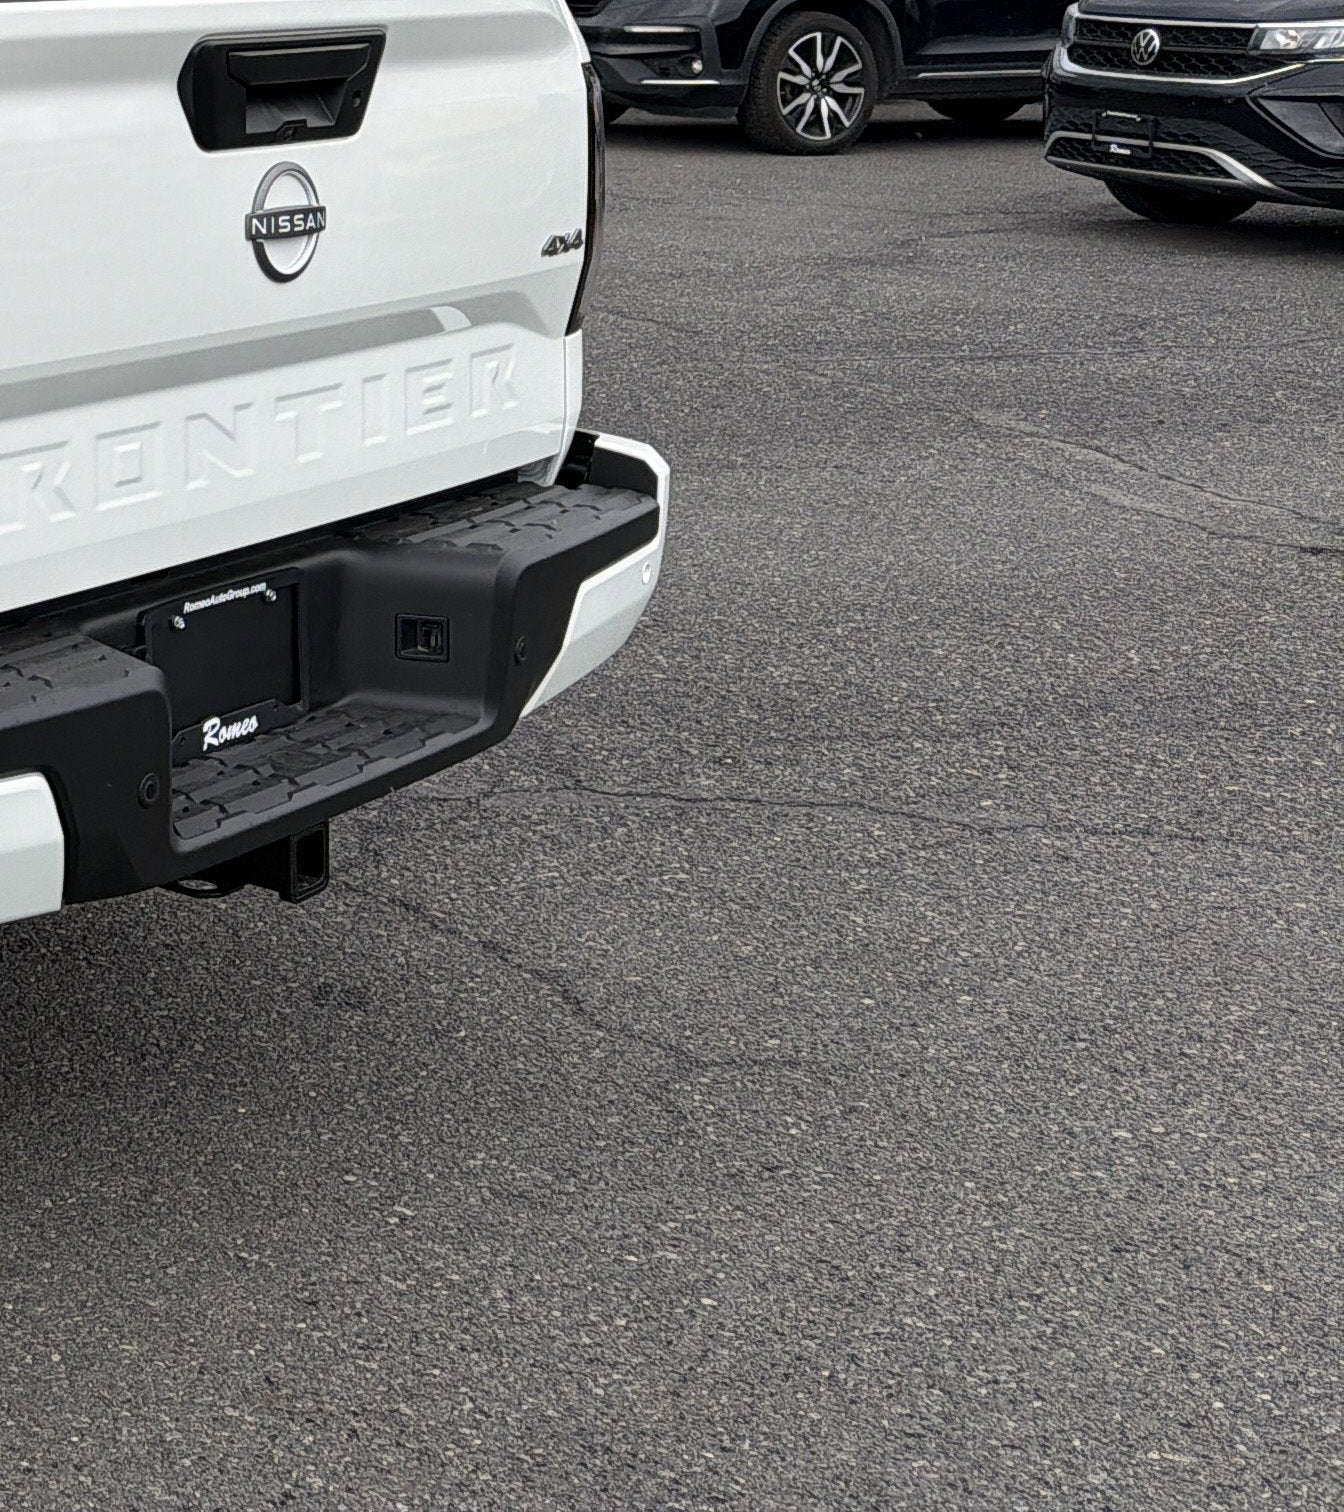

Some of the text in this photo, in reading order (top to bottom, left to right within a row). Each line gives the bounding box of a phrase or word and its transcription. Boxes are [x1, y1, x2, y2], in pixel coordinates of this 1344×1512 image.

[252, 210, 325, 235] NISSAN
[183, 582, 267, 614] RomeoAutoGroup.com
[202, 714, 259, 752] Romeo
